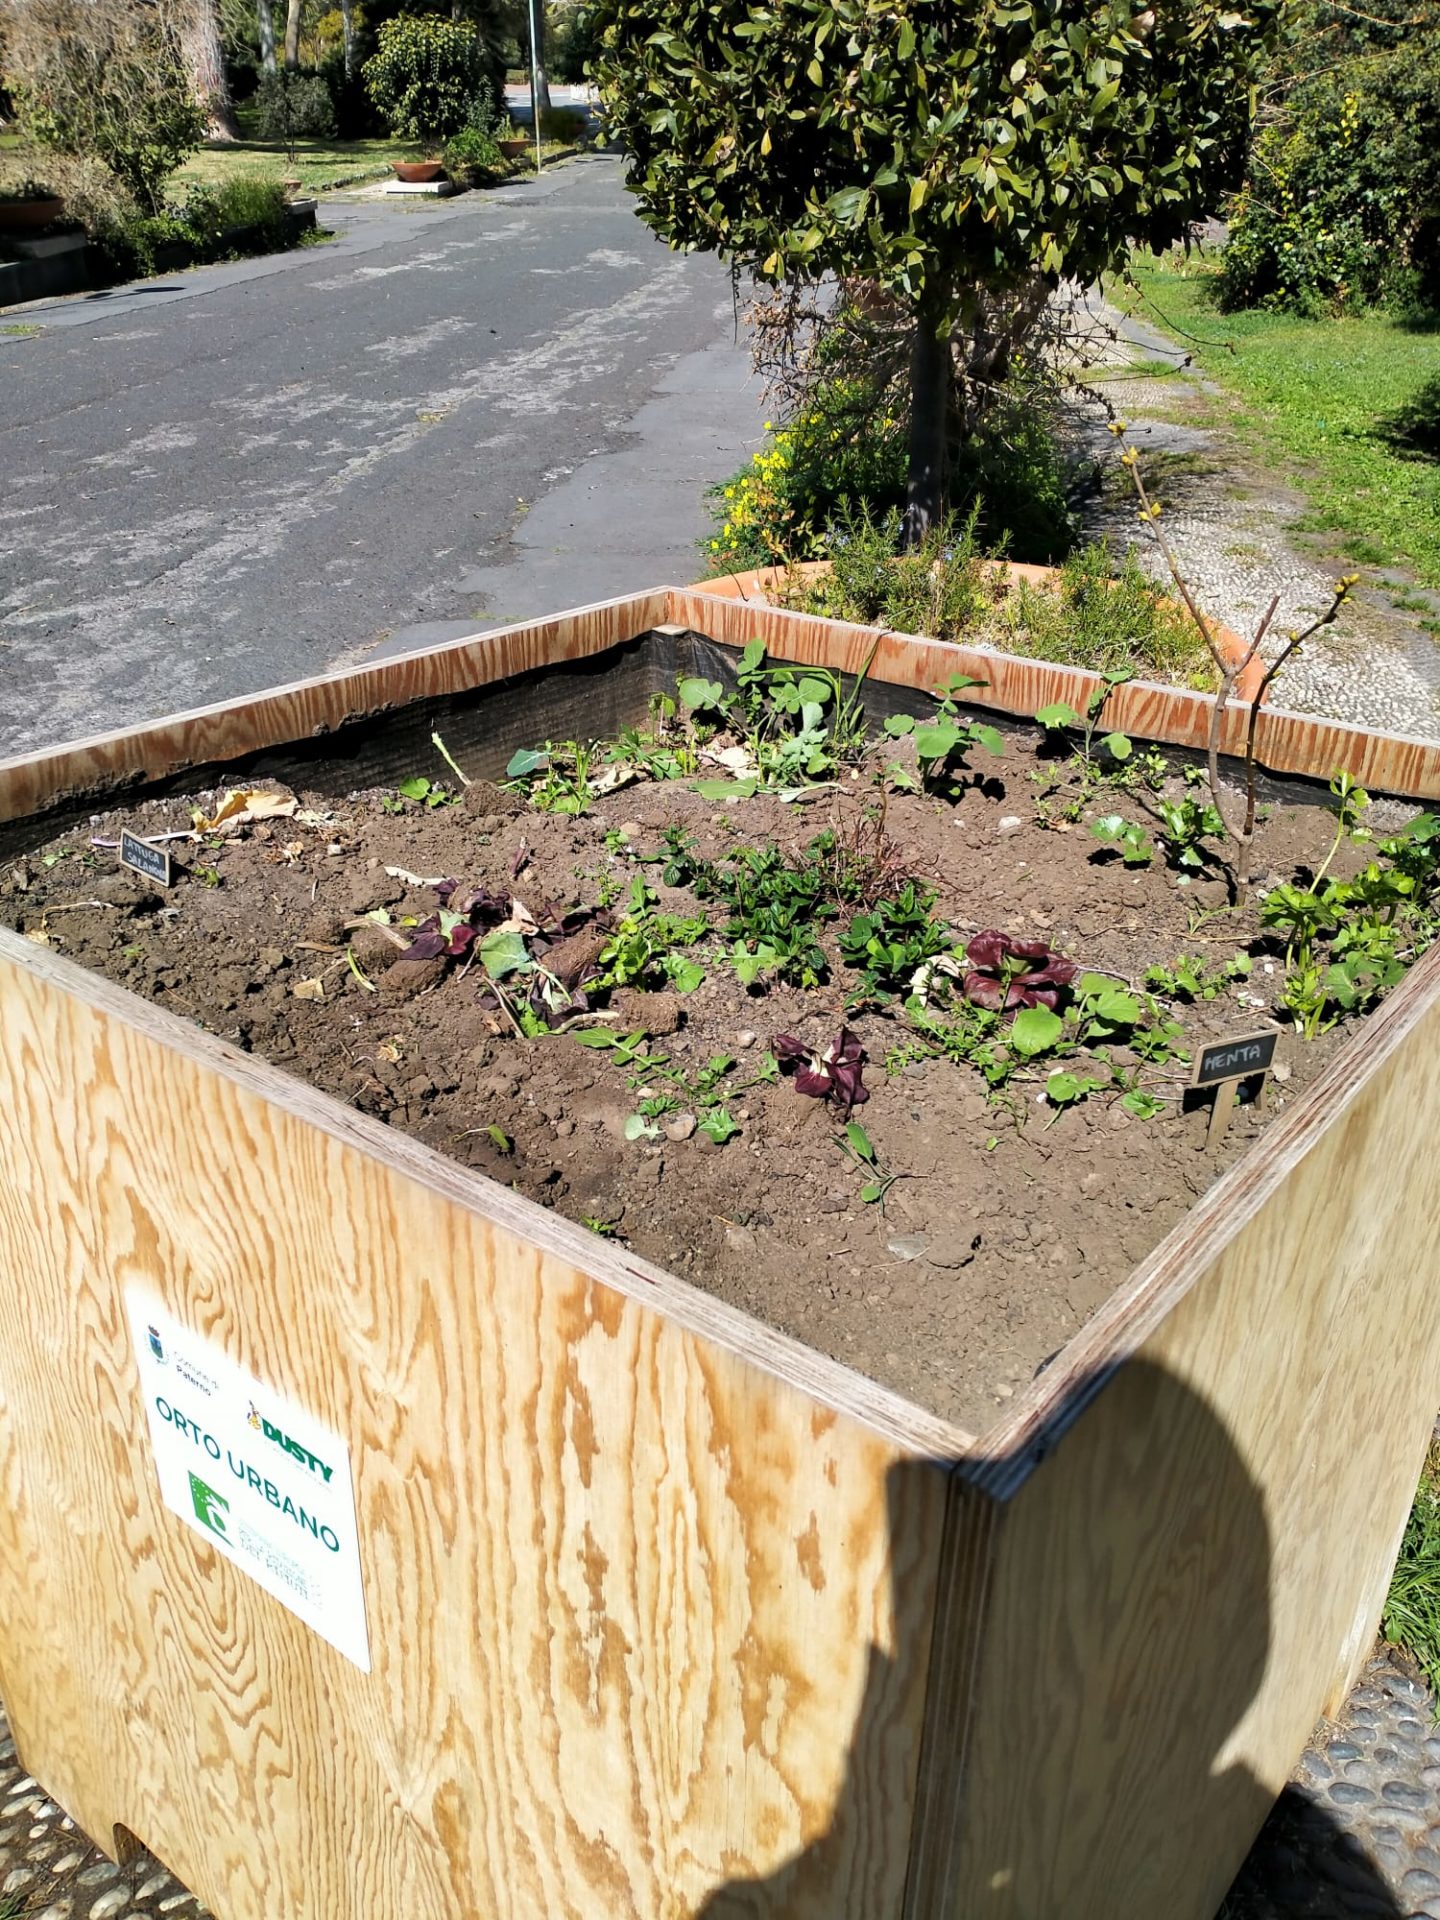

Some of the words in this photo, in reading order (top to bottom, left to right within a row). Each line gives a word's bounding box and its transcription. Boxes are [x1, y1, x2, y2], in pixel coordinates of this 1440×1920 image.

[123, 836, 160, 865] LATTUGA
[1204, 1044, 1261, 1071] MENTA
[155, 1396, 221, 1460] ORTO
[227, 1450, 340, 1553] URBANO
[262, 1418, 334, 1484] DUSTY
